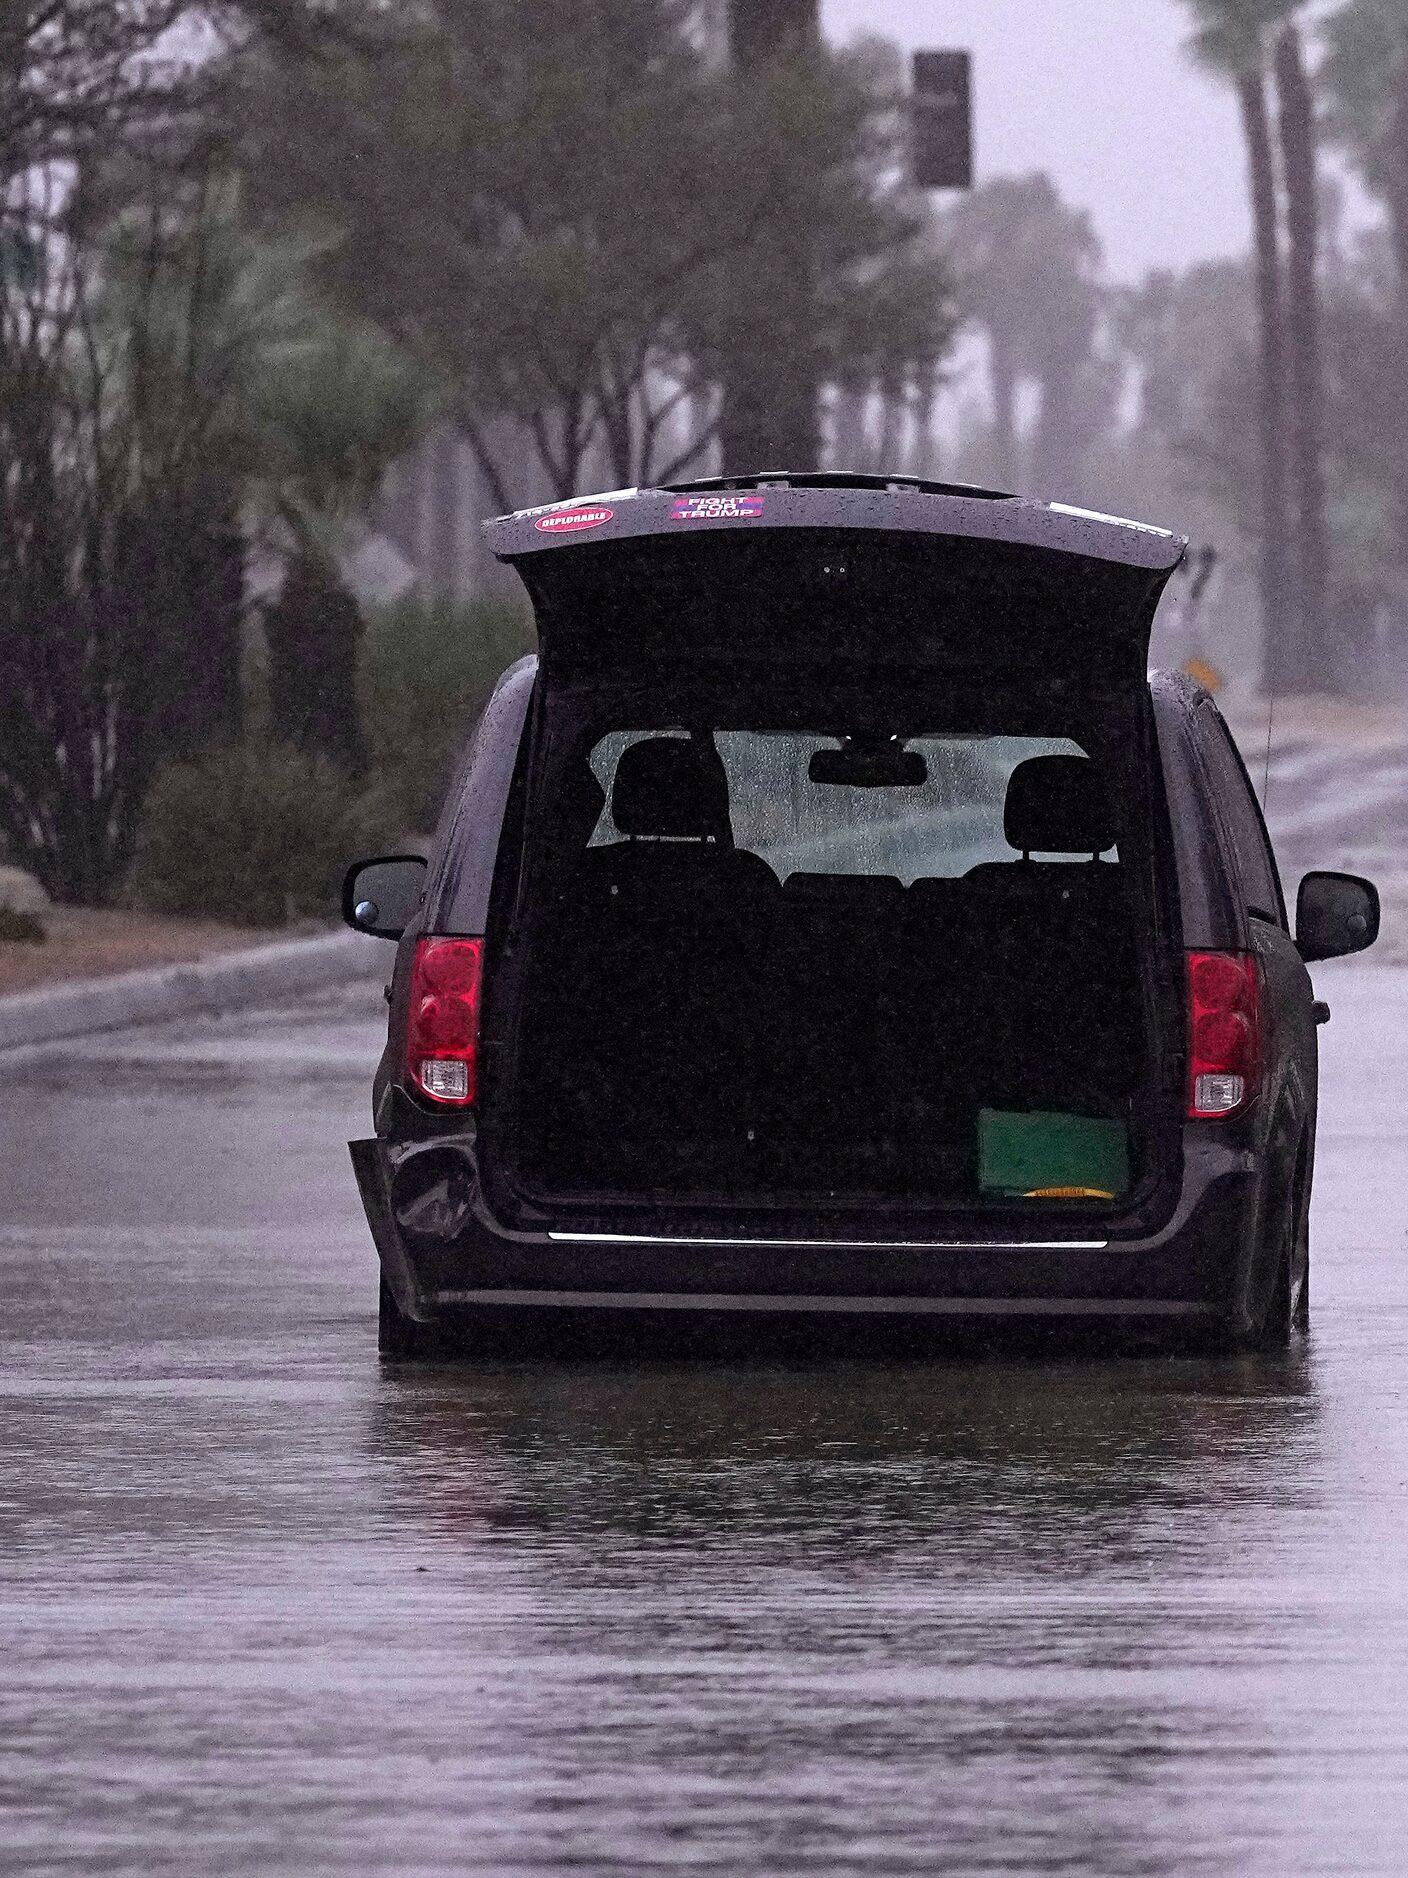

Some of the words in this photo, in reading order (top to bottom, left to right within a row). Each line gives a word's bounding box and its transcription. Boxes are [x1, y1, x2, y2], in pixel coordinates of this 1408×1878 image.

[688, 497, 748, 505] FIGHT
[697, 503, 737, 511] FOR
[679, 509, 754, 518] TRUMP
[542, 512, 606, 527] DEPLORABLE
